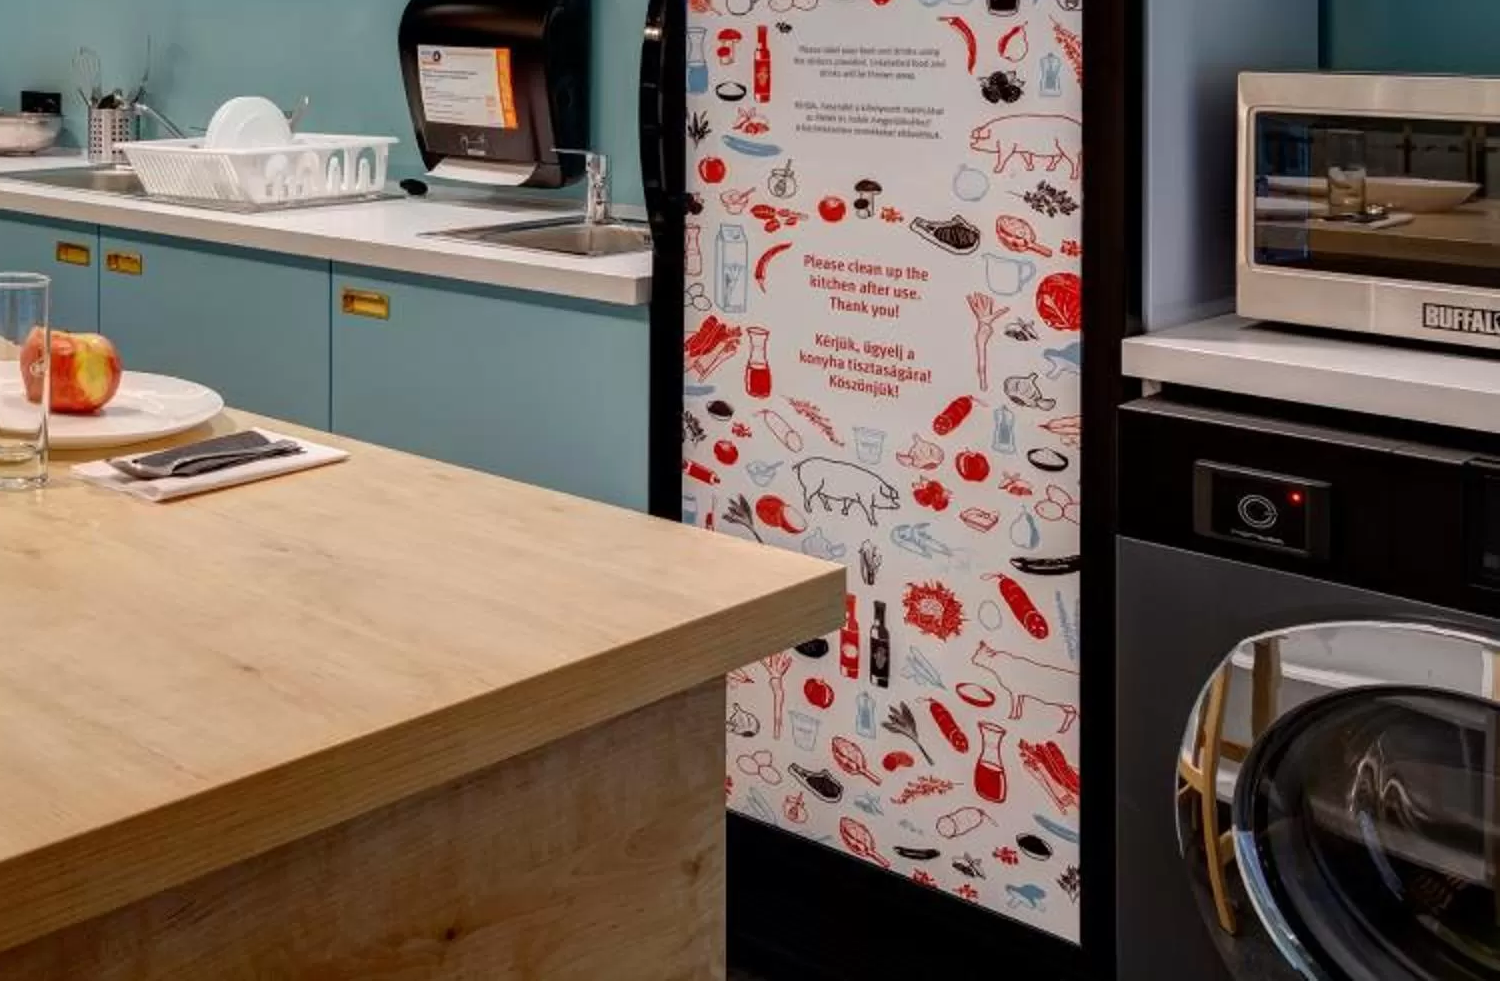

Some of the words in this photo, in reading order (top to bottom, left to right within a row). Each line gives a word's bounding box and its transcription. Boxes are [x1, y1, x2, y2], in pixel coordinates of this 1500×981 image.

[803, 254, 845, 271] Please
[847, 260, 883, 276] clean
[886, 267, 903, 281] up
[906, 266, 929, 281] the
[809, 274, 857, 293] kitchen
[859, 281, 890, 296] after
[893, 287, 922, 300] use.
[829, 296, 868, 314] Thank
[871, 304, 900, 319] you!
[799, 349, 845, 370] konyha
[907, 349, 915, 361] a
